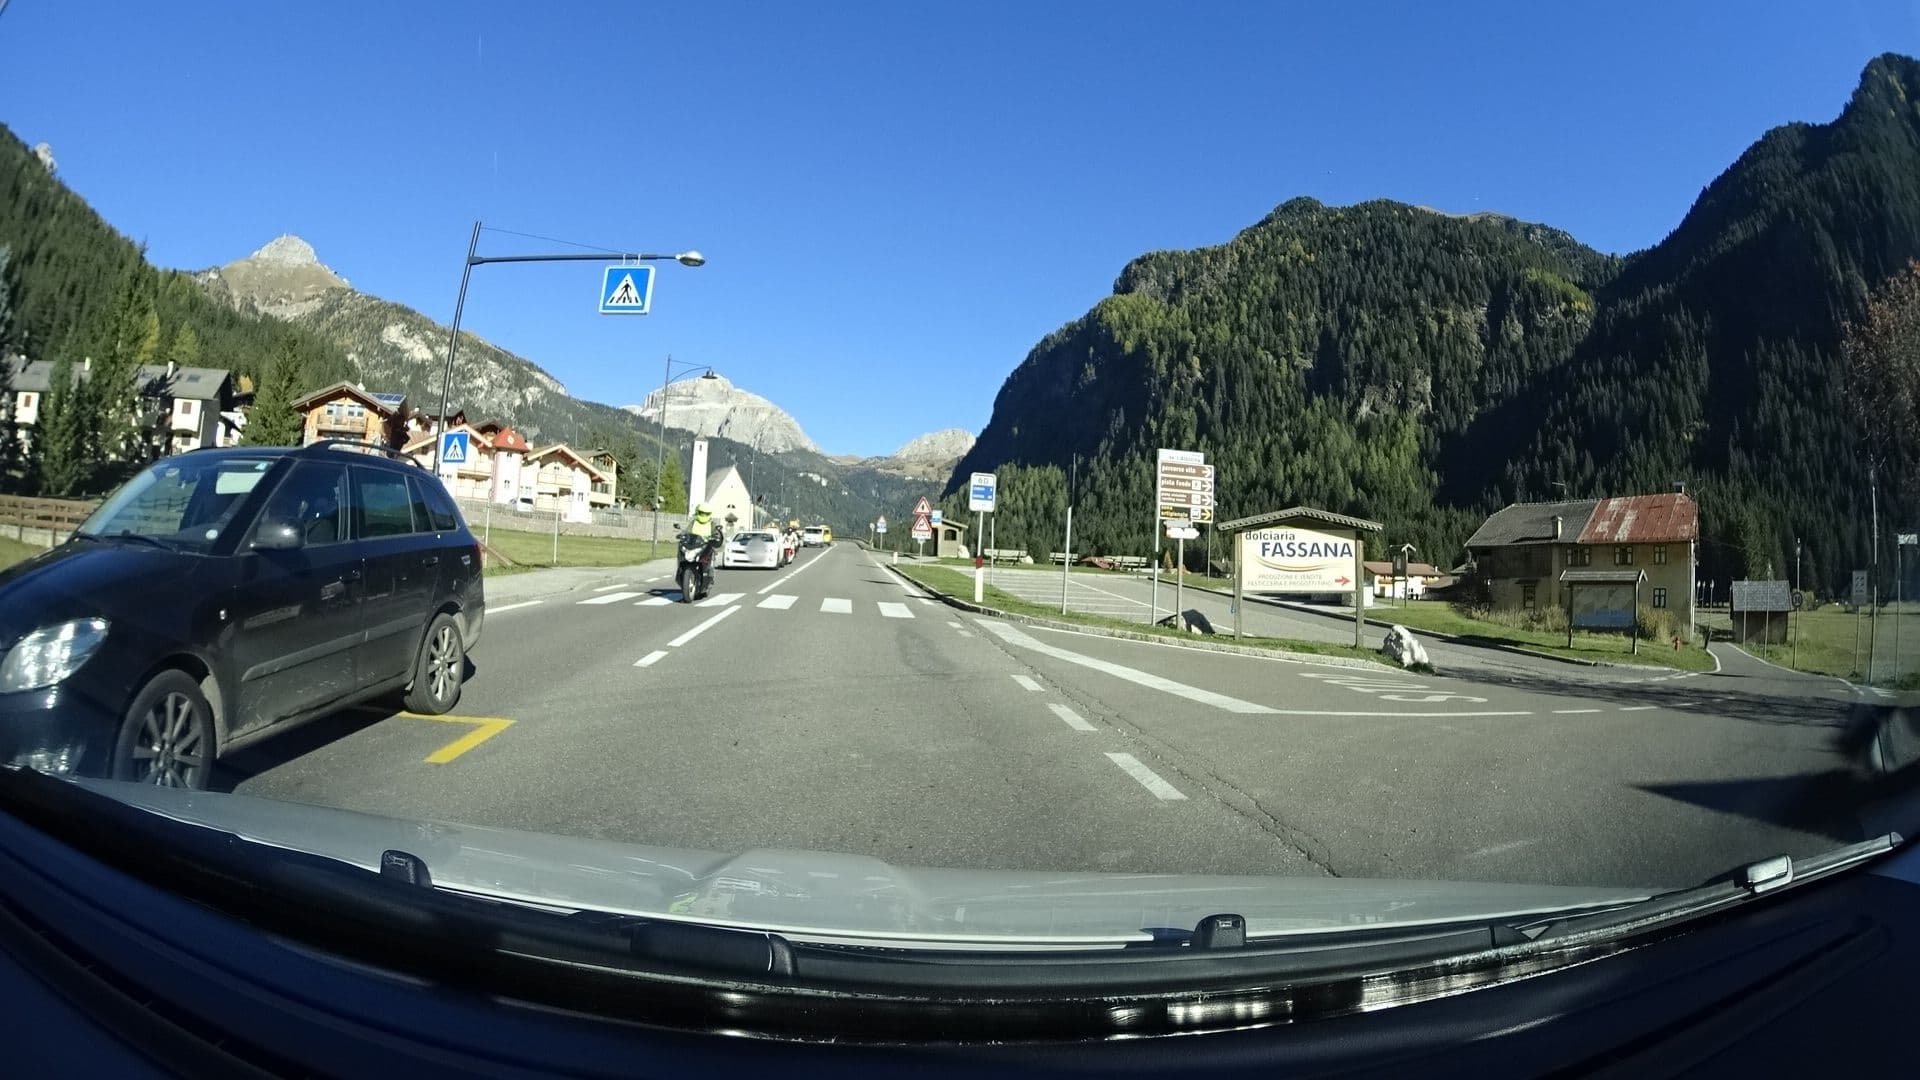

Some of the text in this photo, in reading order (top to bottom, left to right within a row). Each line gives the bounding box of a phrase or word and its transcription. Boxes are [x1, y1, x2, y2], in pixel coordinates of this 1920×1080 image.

[1161, 478, 1175, 486] pista
[1245, 530, 1296, 541] dolciaria
[1261, 542, 1353, 558] FASSANA
